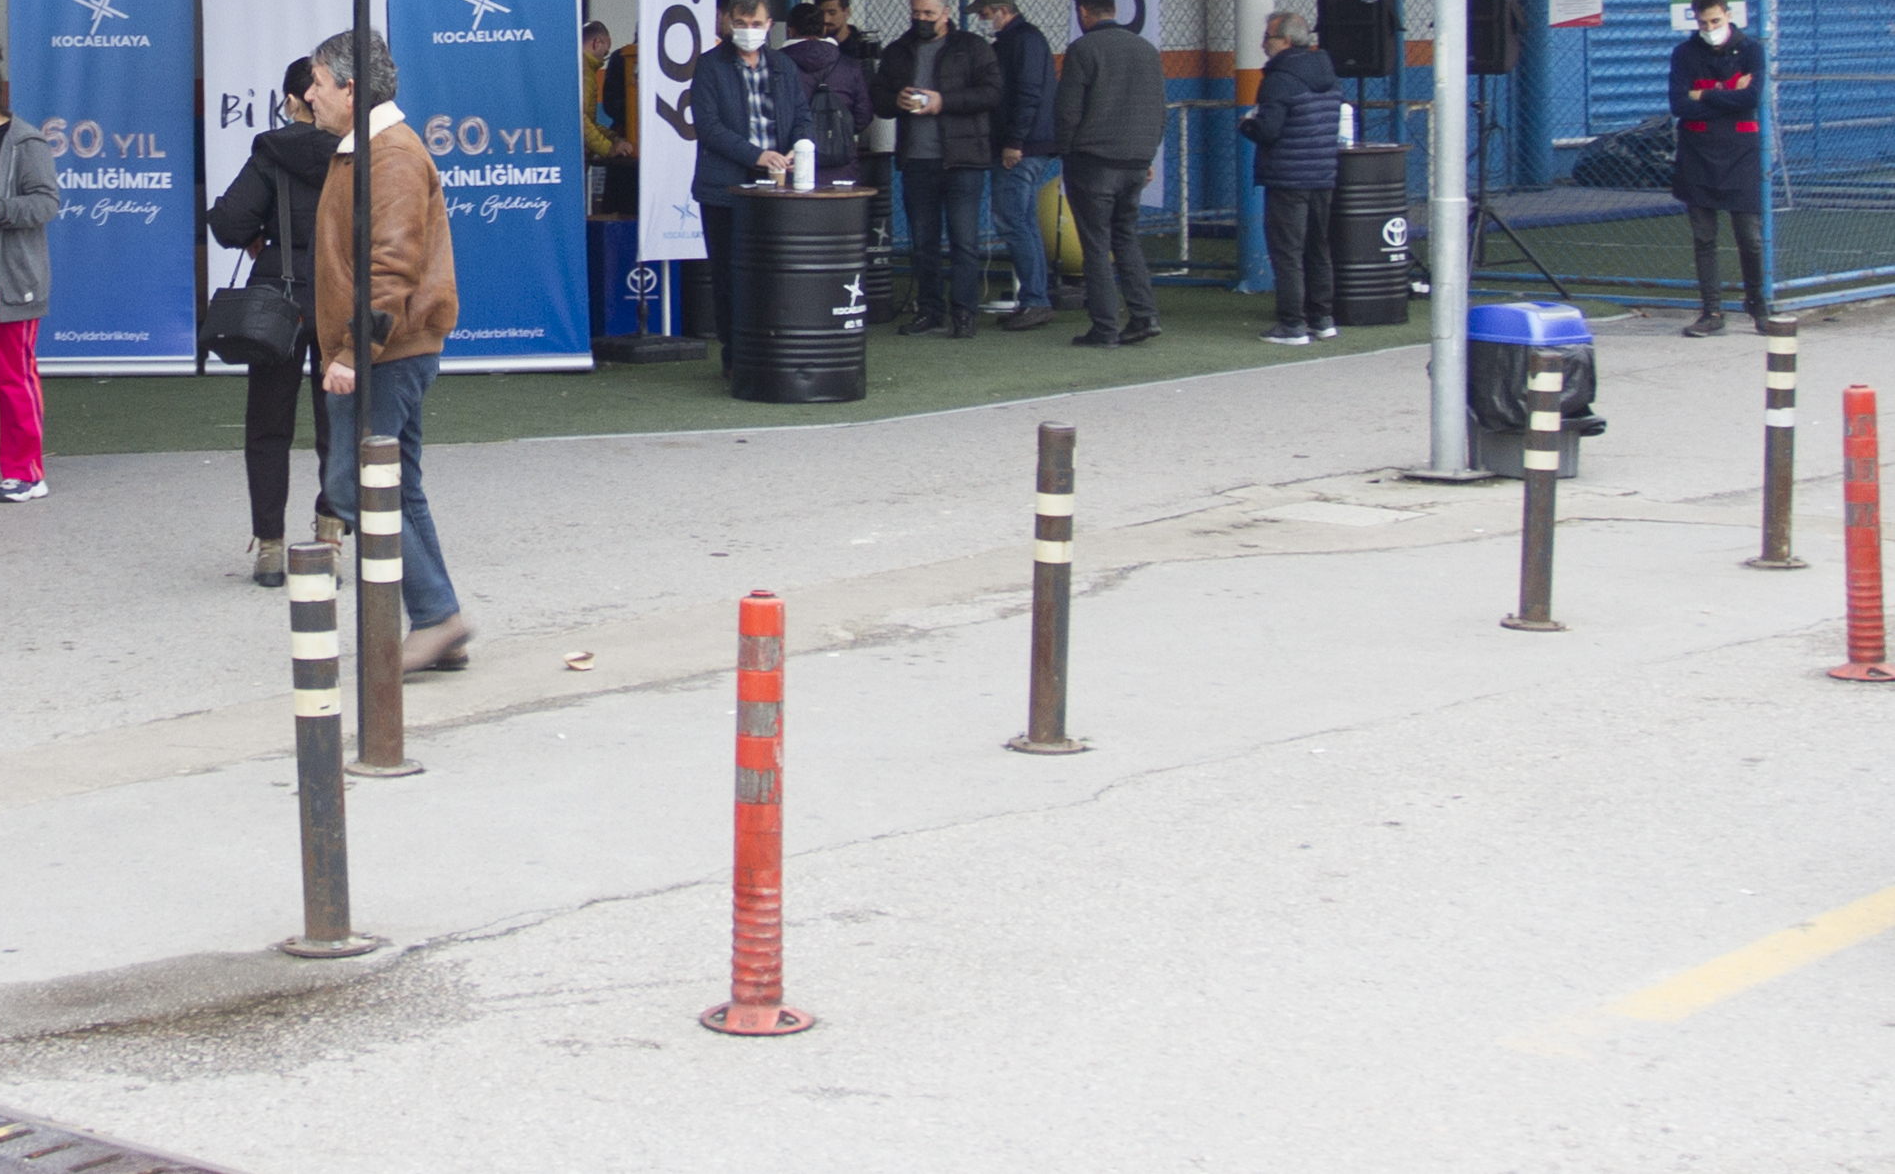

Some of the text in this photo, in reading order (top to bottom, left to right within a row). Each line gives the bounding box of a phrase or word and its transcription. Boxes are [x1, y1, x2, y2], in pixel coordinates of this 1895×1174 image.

[51, 34, 151, 48] KOCAELKAYA
[432, 29, 534, 44] KOCAELKAYA
[221, 88, 255, 129] Bi
[113, 133, 166, 158] YIL
[423, 114, 554, 156] 60. YIL
